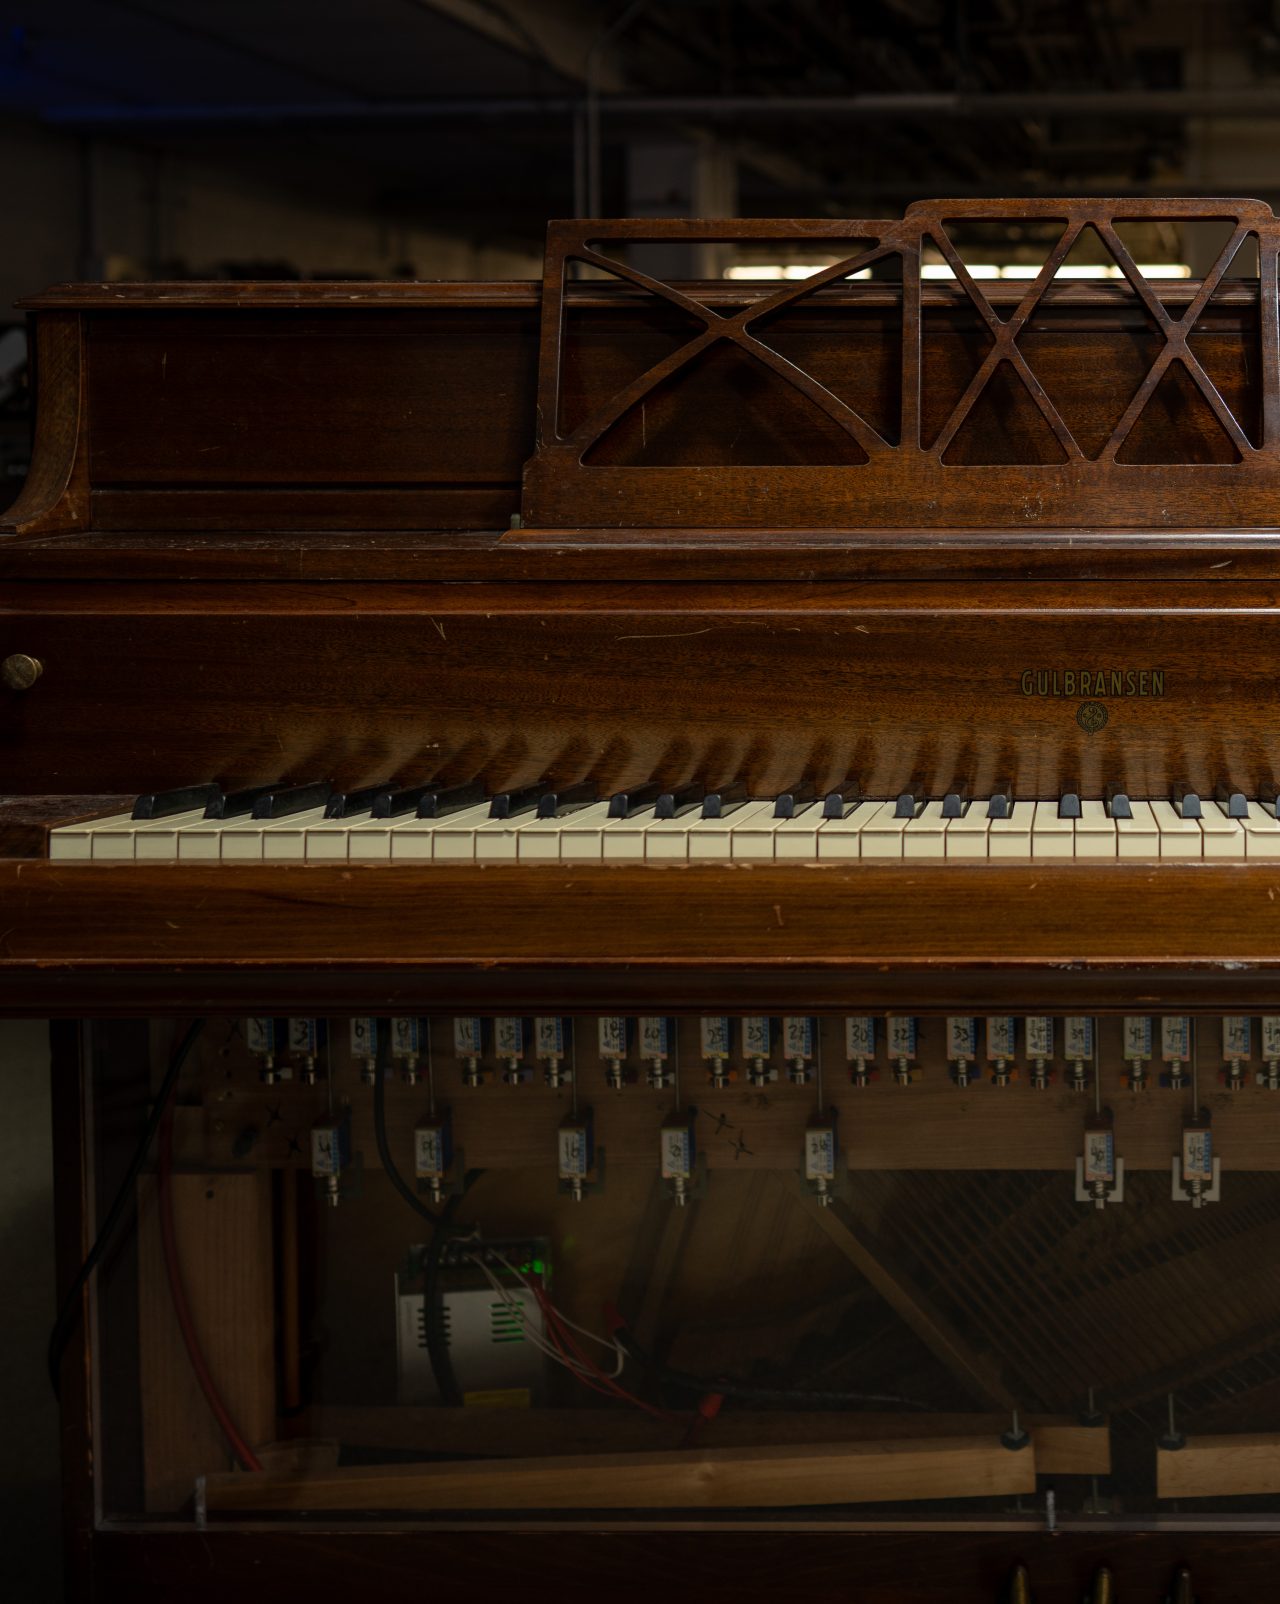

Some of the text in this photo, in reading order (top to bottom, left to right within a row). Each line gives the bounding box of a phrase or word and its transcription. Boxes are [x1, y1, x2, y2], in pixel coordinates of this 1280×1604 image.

[1021, 669, 1165, 697] GULBRANSEN
[893, 1028, 909, 1042] 32
[954, 1025, 969, 1042] 33
